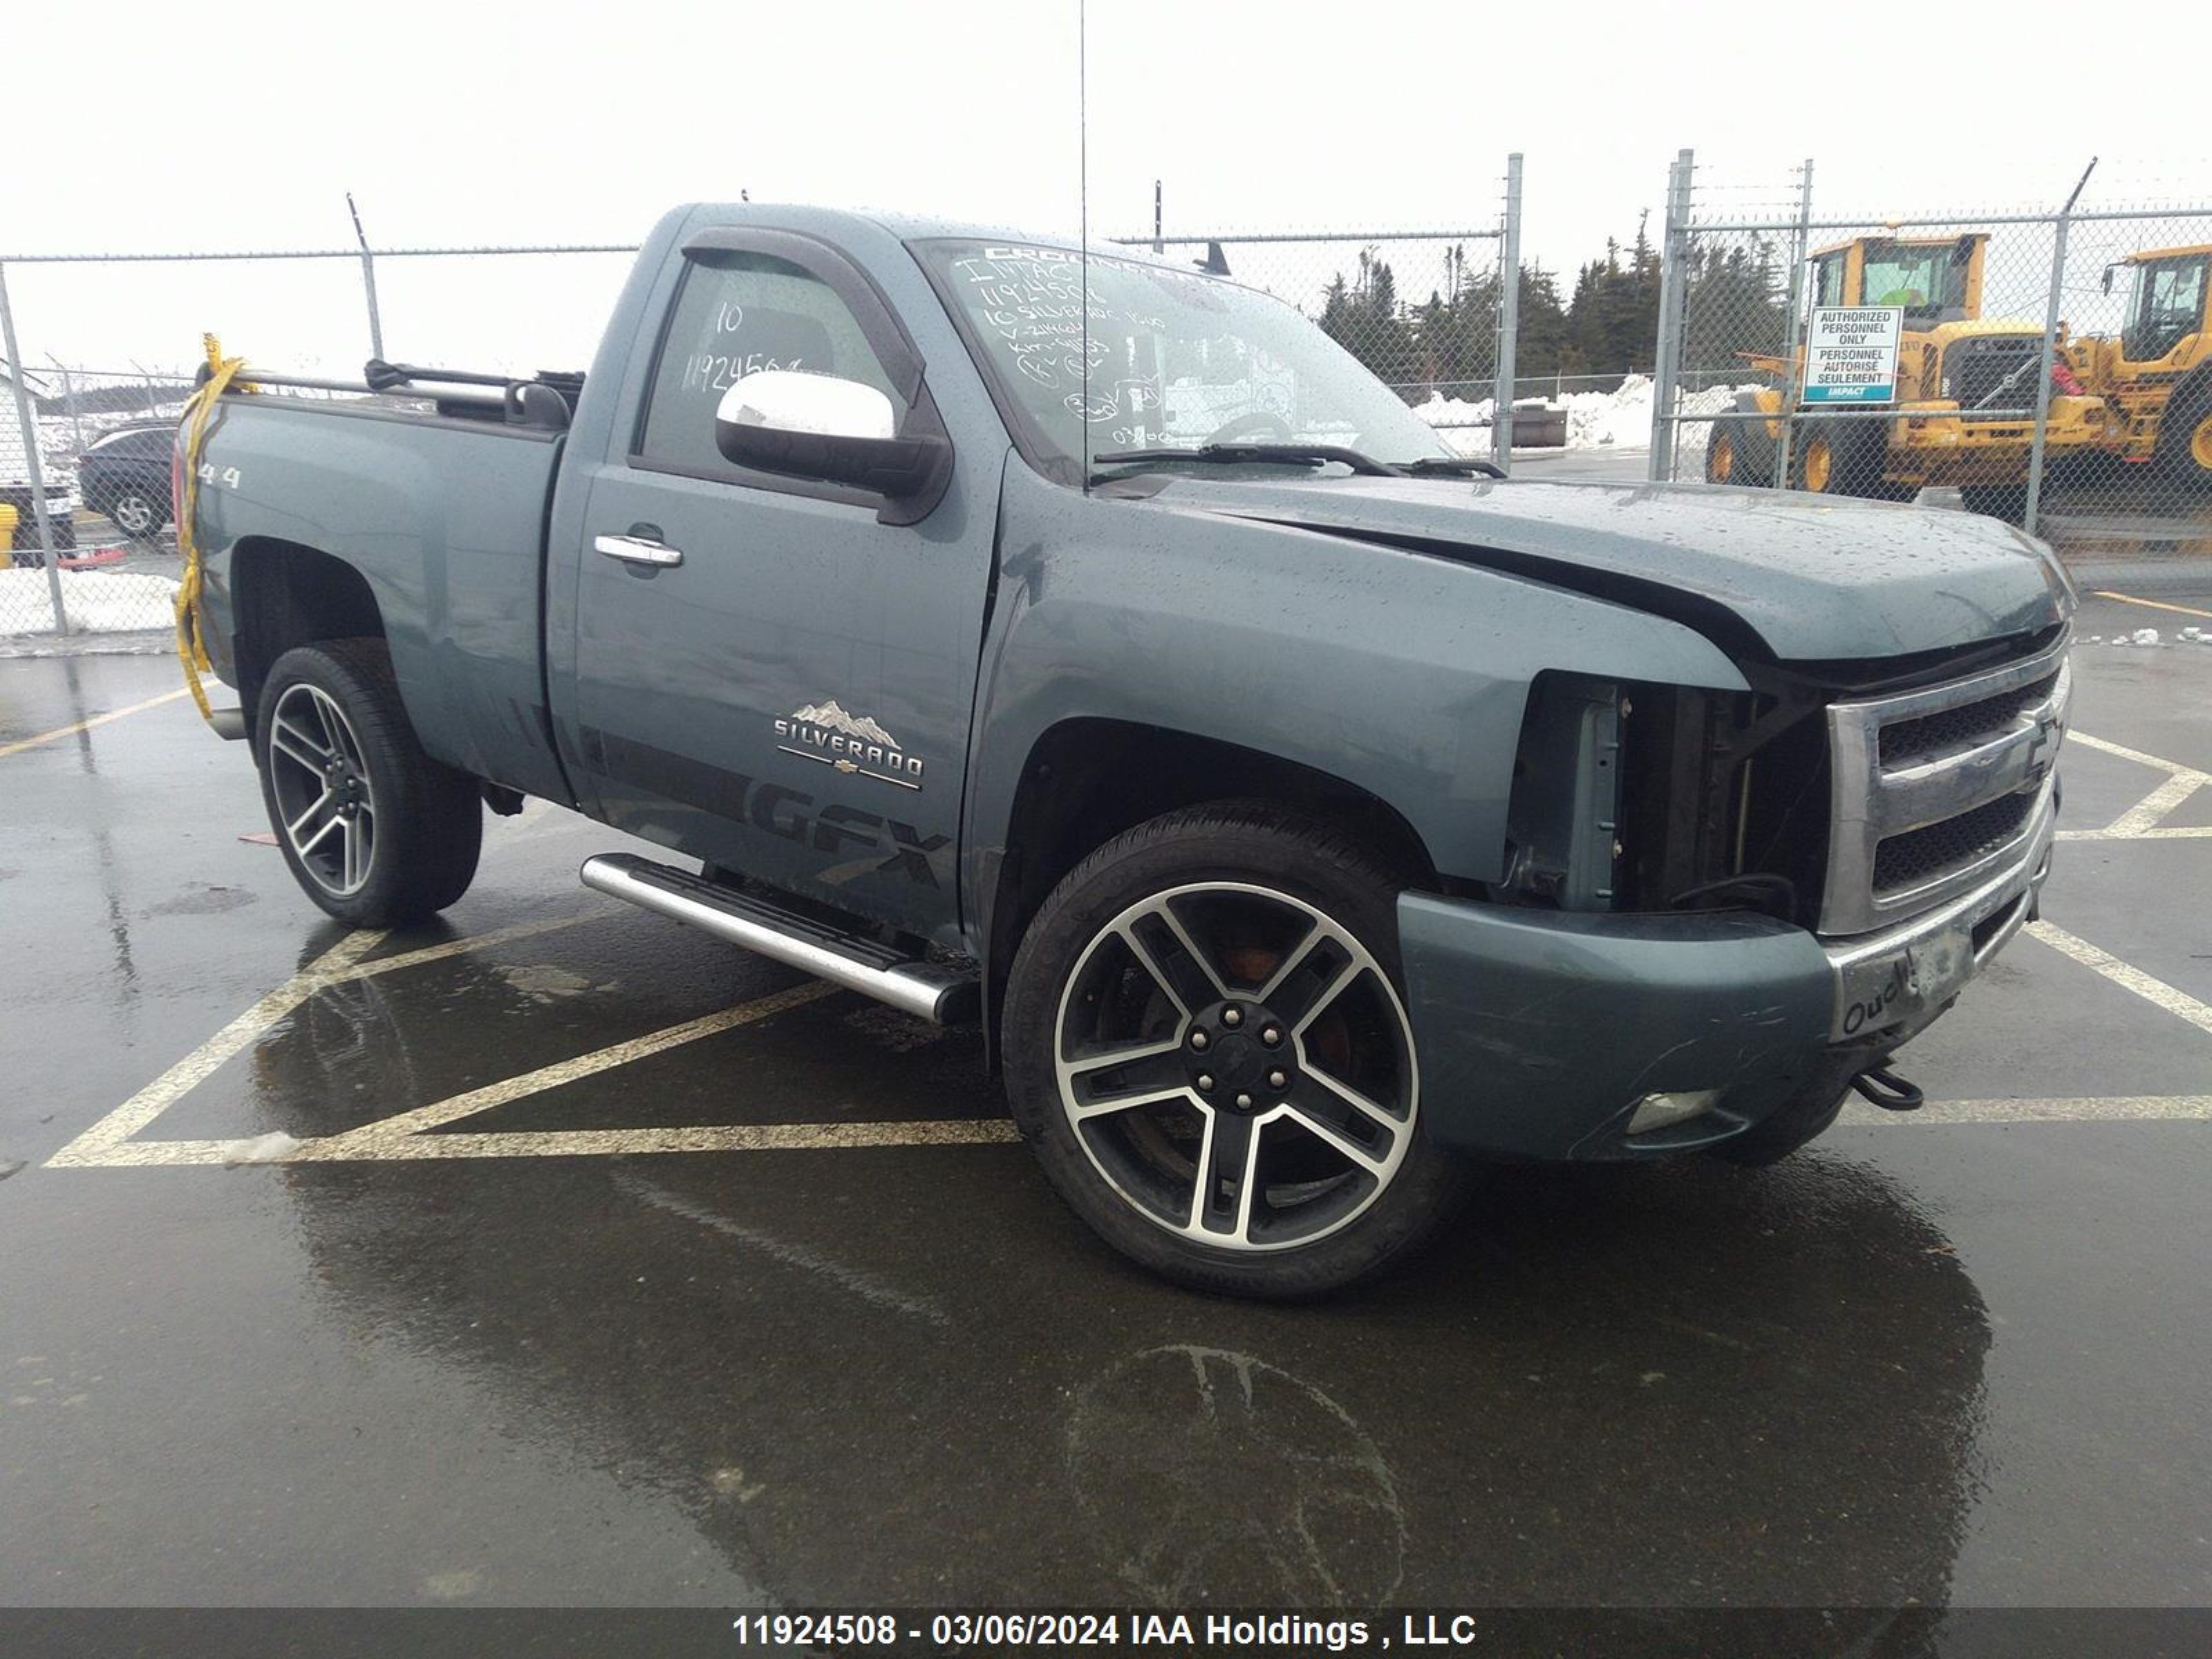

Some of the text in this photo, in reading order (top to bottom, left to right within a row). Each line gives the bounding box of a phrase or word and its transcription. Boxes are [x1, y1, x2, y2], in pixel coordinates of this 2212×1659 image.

[717, 302, 742, 332] 10
[1820, 312, 1891, 322] AUTHORIZED
[1821, 323, 1886, 333] PERSONNEL
[1839, 335, 1867, 344] ONLY
[1820, 350, 1884, 359] PERSONNEL
[1818, 373, 1882, 384] SEULEMENT
[1828, 388, 1865, 396] IMPACT
[774, 719, 924, 777] SILVERADO
[749, 782, 952, 890] GFX
